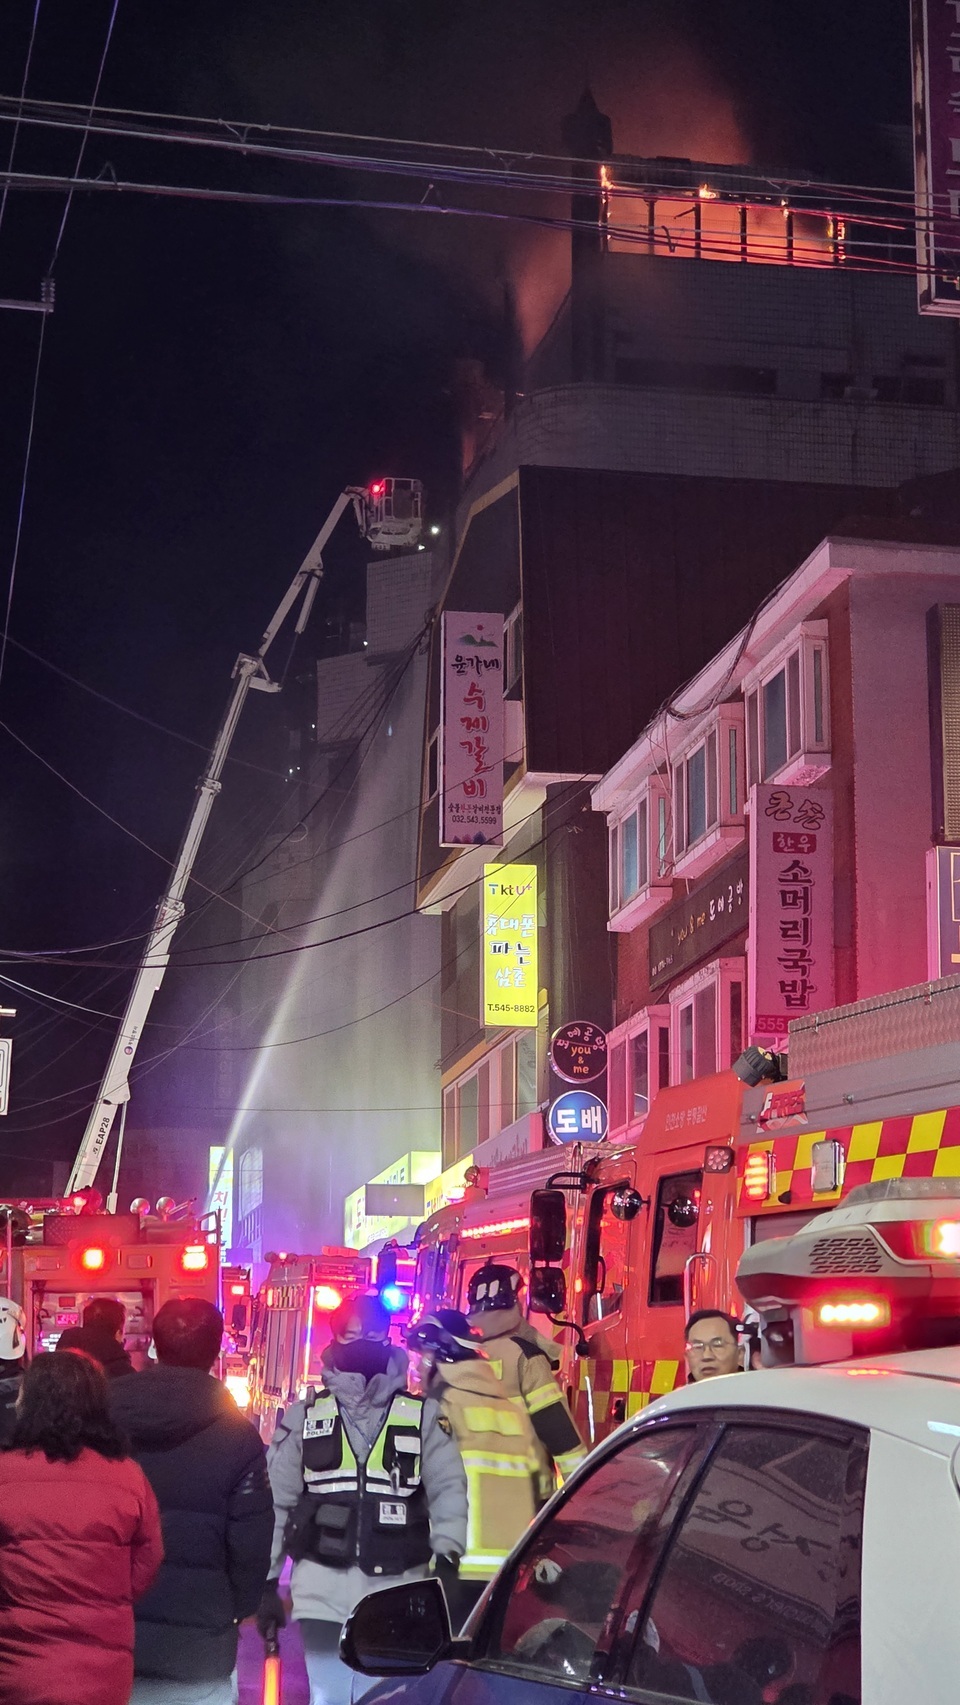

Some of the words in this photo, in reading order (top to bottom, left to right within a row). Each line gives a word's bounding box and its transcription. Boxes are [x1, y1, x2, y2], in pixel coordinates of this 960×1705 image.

[451, 654, 501, 675] 윤가네
[460, 681, 494, 798] 수제갈비
[451, 815, 497, 824] 032.543.5599
[777, 835, 811, 852] 한우
[488, 884, 499, 895] T
[501, 885, 514, 896] kt
[486, 914, 536, 938] 휴대폰
[777, 859, 816, 1009] 소머리국밥
[490, 941, 531, 966] 파는
[495, 967, 526, 988] 삼촌
[487, 1003, 536, 1014] T.545-8882
[571, 1046, 592, 1057] you
[577, 1056, 585, 1064] &
[573, 1066, 590, 1074] me
[555, 1105, 603, 1135] 도배
[96, 1117, 110, 1147] EAP28
